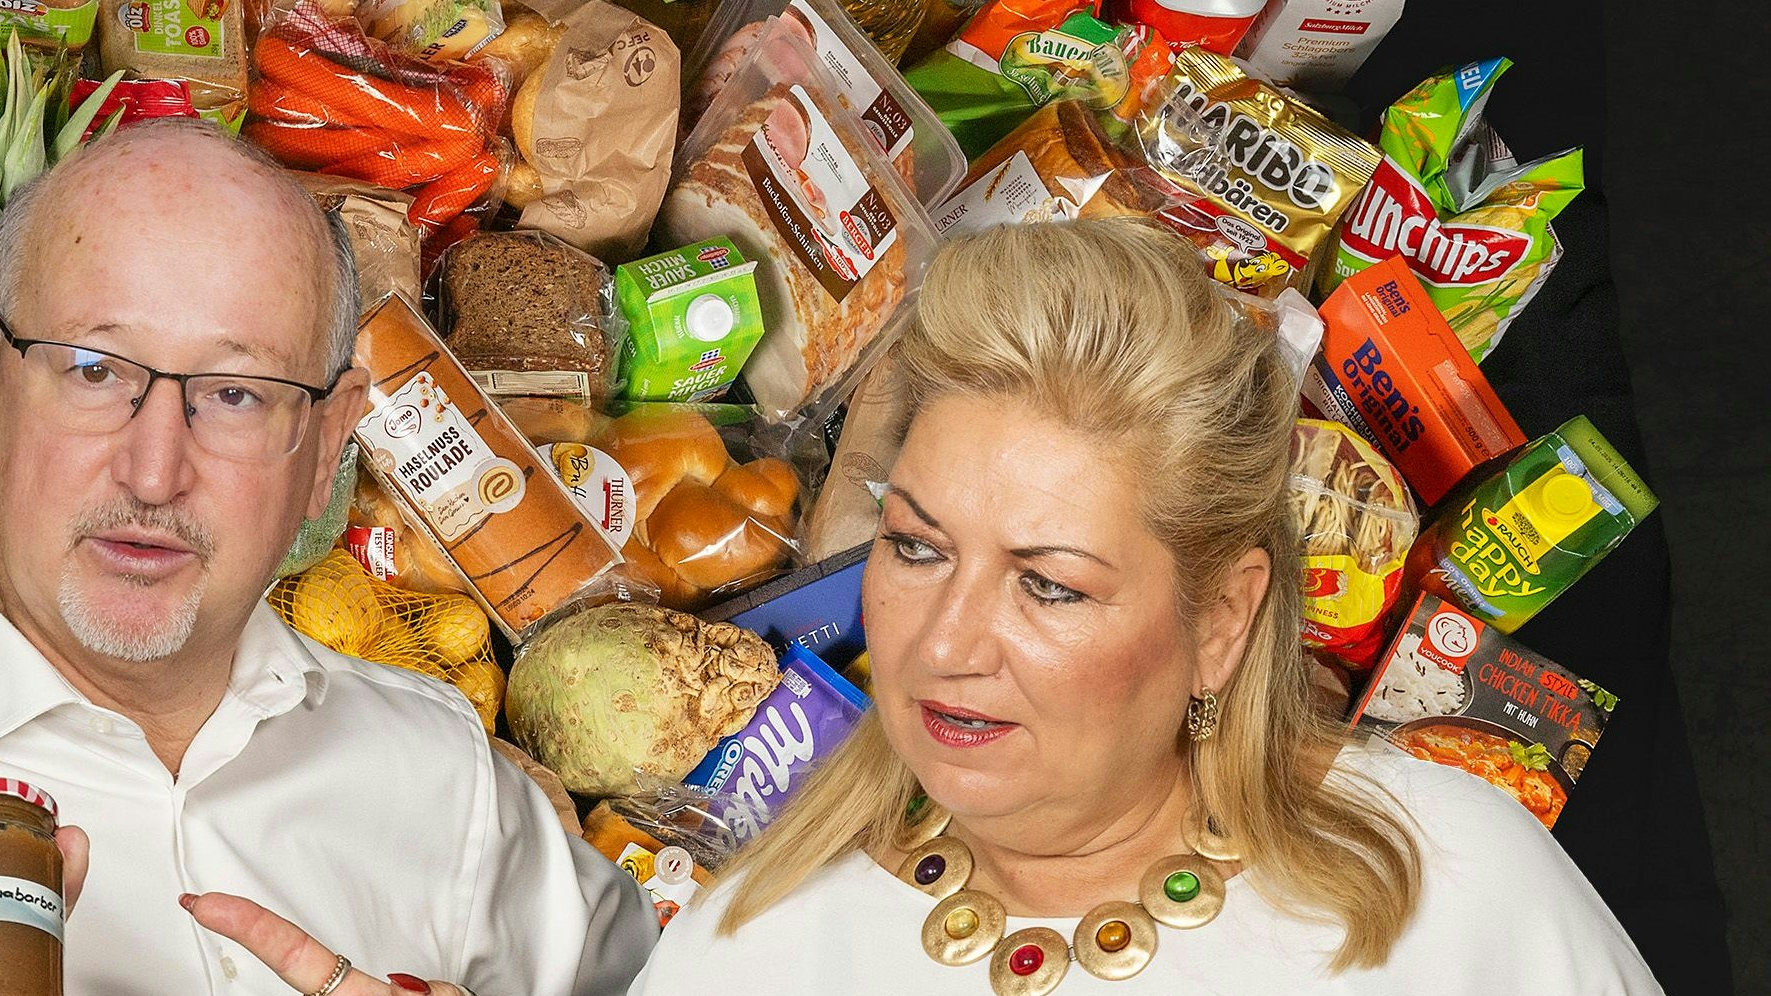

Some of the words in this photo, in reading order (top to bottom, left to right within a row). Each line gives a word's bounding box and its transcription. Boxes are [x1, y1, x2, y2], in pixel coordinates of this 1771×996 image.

[154, 2, 163, 35] DINKEL
[1304, 20, 1364, 32] SalzburgMilch
[616, 31, 650, 51] PEFC
[1282, 42, 1356, 53] Schlagobers
[1297, 37, 1350, 47] Premium
[878, 94, 895, 117] Nr.
[892, 109, 907, 130] 03
[1165, 81, 1338, 210] HARIBO
[762, 177, 824, 271] Backofen-Schinken
[866, 193, 880, 216] Nr.
[878, 209, 892, 230] 03
[842, 216, 872, 258] BERGER
[1221, 217, 1236, 229] Das
[1236, 223, 1262, 243] Original
[1239, 233, 1255, 246] 1922
[639, 254, 688, 276] MILCH
[646, 264, 697, 289] SAUER
[1375, 287, 1401, 318] Original
[1383, 280, 1410, 314] Ben's
[668, 376, 720, 400] MILCH
[673, 365, 727, 390] SAUER
[1352, 337, 1426, 443] Ben's
[390, 410, 412, 431] Jomo
[1343, 357, 1410, 453] Original
[1464, 425, 1478, 443] 500
[398, 426, 460, 479] HASELNUSS
[410, 439, 474, 494] ROULADE
[610, 477, 624, 533] THURNER
[1461, 498, 1546, 597] happy
[1496, 523, 1533, 569] RAUCH
[1451, 541, 1509, 597] day
[1421, 648, 1462, 674] YOUCOOK
[1498, 649, 1535, 678] INDIAN
[1543, 673, 1576, 698] STYLE
[1478, 664, 1539, 708] CHICKEN
[1542, 693, 1582, 732] TIKKA
[1503, 702, 1518, 719] MIT
[1517, 708, 1539, 730] HUHN
[705, 742, 743, 796] OREO
